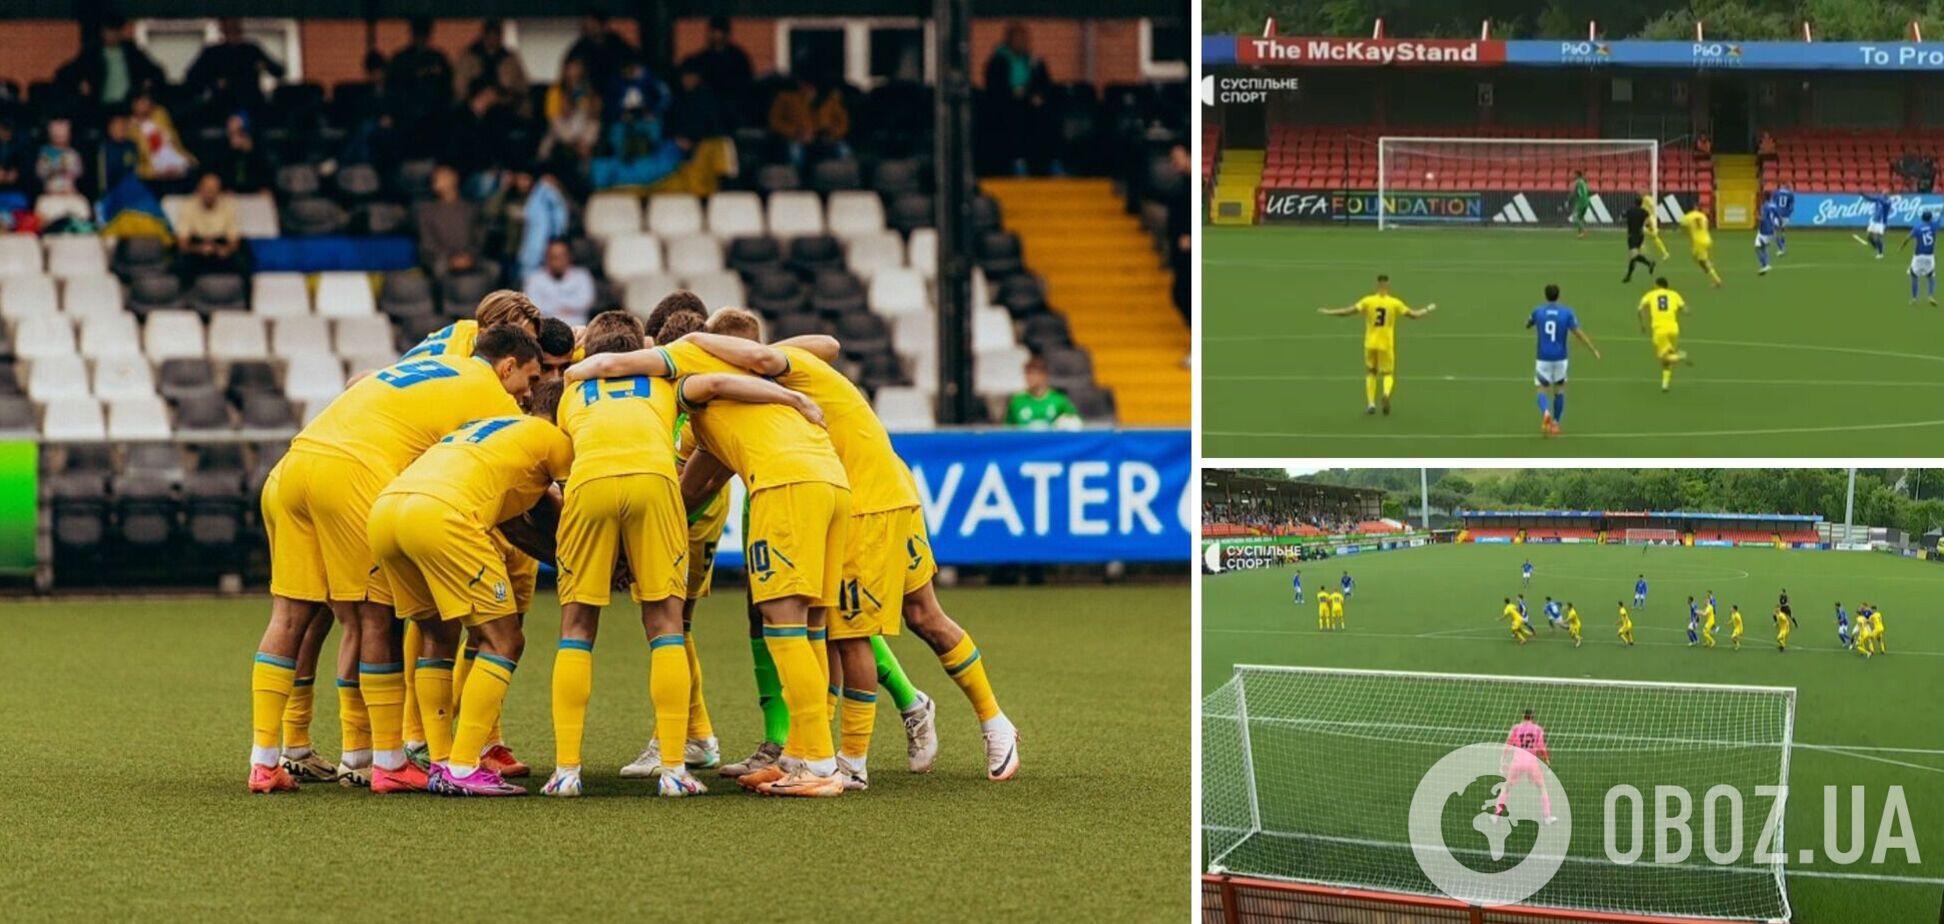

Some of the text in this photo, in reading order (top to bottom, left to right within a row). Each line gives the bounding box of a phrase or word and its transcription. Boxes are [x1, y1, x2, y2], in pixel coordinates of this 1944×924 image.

[1253, 41, 1301, 59] The
[1859, 46, 1889, 65] To
[1266, 194, 1482, 215] UEFA FOUNDATION
[1374, 307, 1386, 326] 3
[1545, 320, 1556, 343] 9
[749, 540, 770, 574] 10
